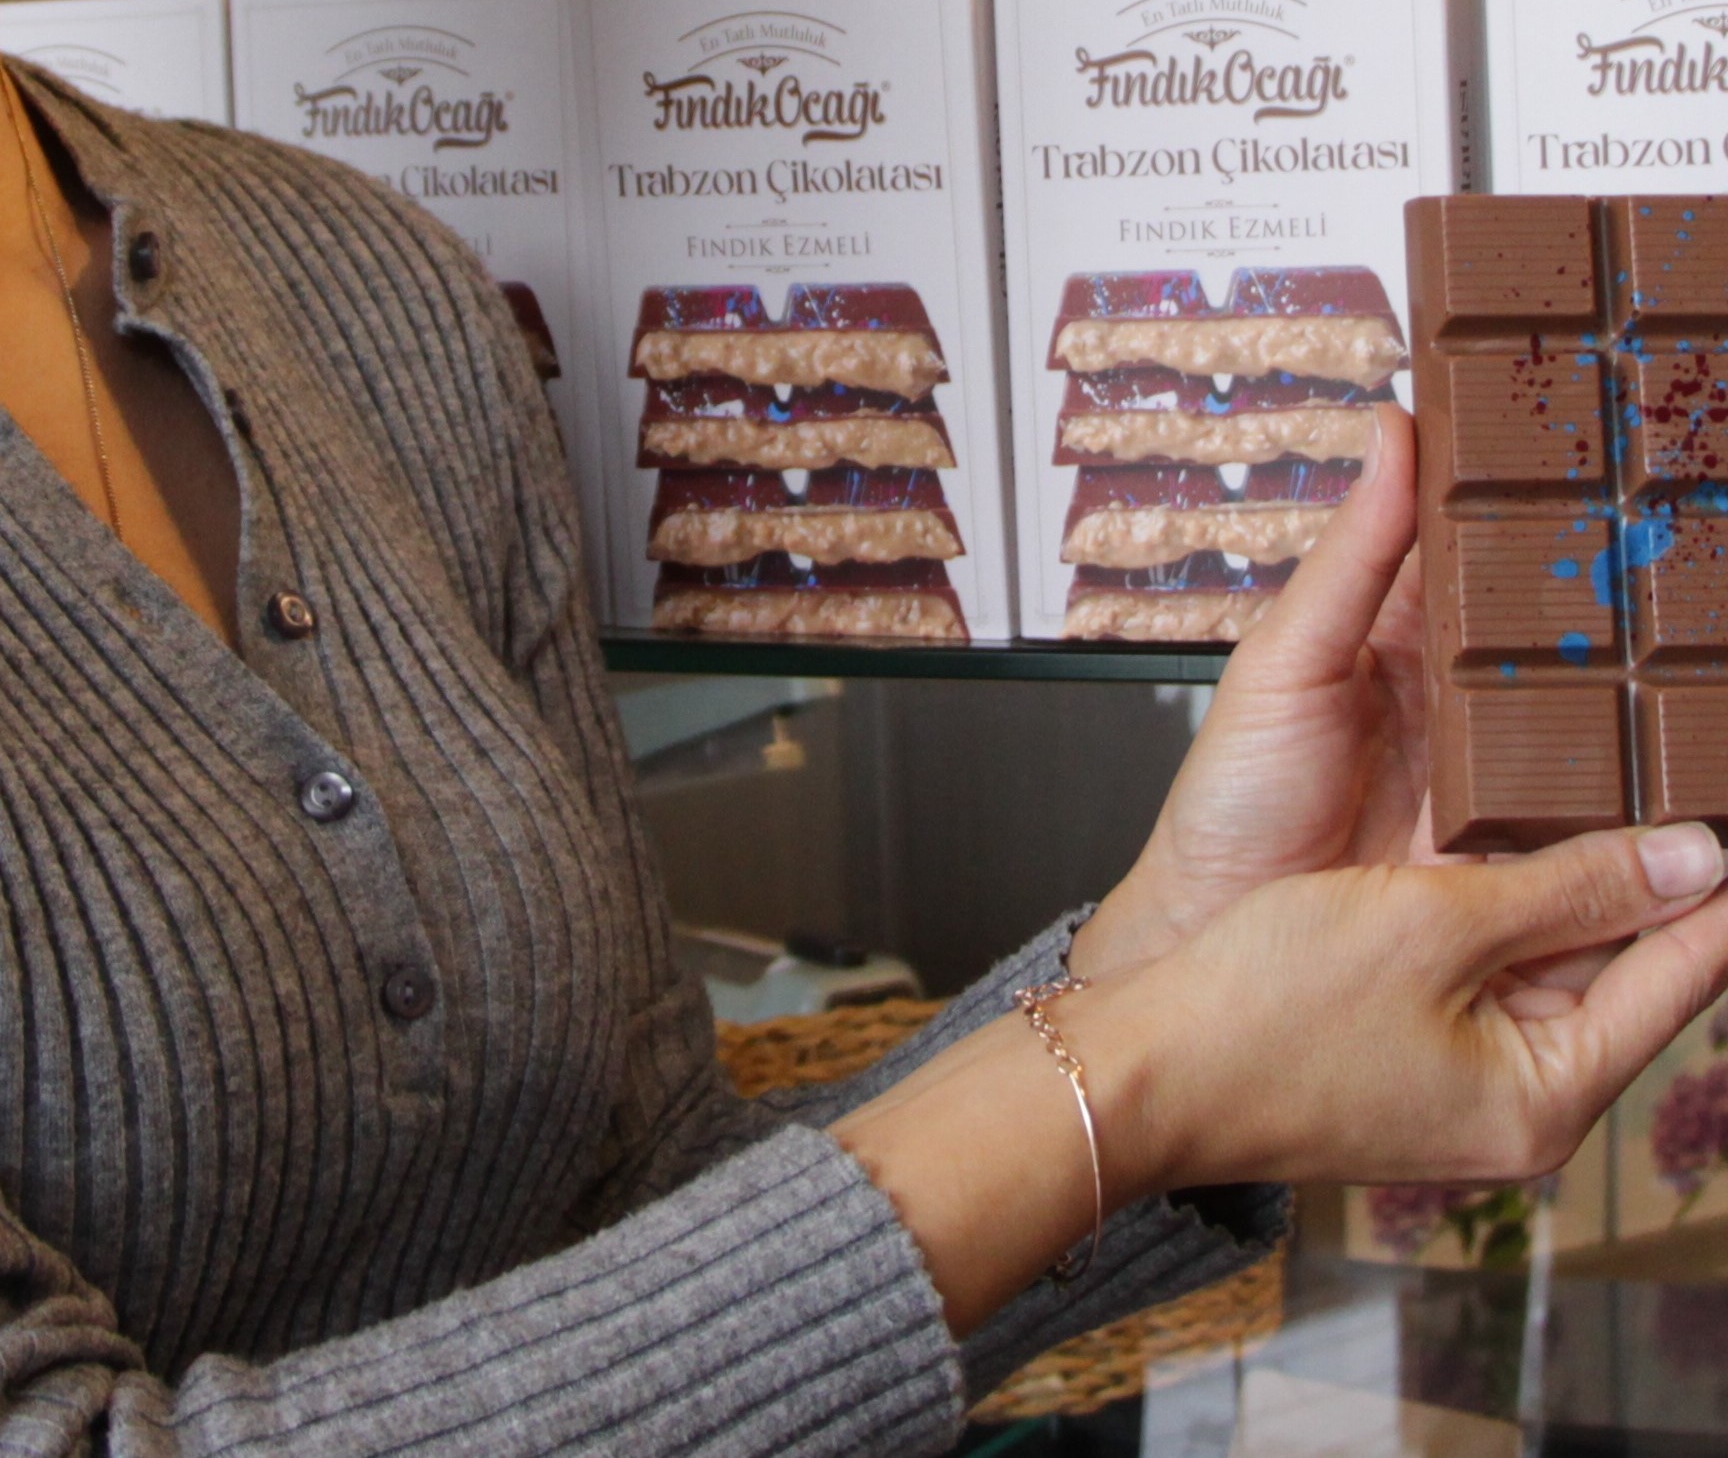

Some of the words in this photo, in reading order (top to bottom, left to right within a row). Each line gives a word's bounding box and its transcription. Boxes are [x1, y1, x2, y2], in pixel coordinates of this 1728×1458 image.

[1140, 9, 1164, 28] En
[760, 23, 827, 49] Mutluluk
[1032, 143, 1203, 181] Trabzon
[1211, 136, 1411, 185] Çikolatası
[1527, 131, 1712, 171] Trabzon
[609, 163, 758, 198] Trabzon
[766, 159, 944, 205] Çikolatası
[1119, 219, 1217, 243] FINDIK
[1229, 212, 1327, 240] EZMELİ
[686, 235, 773, 259] FINDIK
[783, 231, 872, 257] EZMELİ
